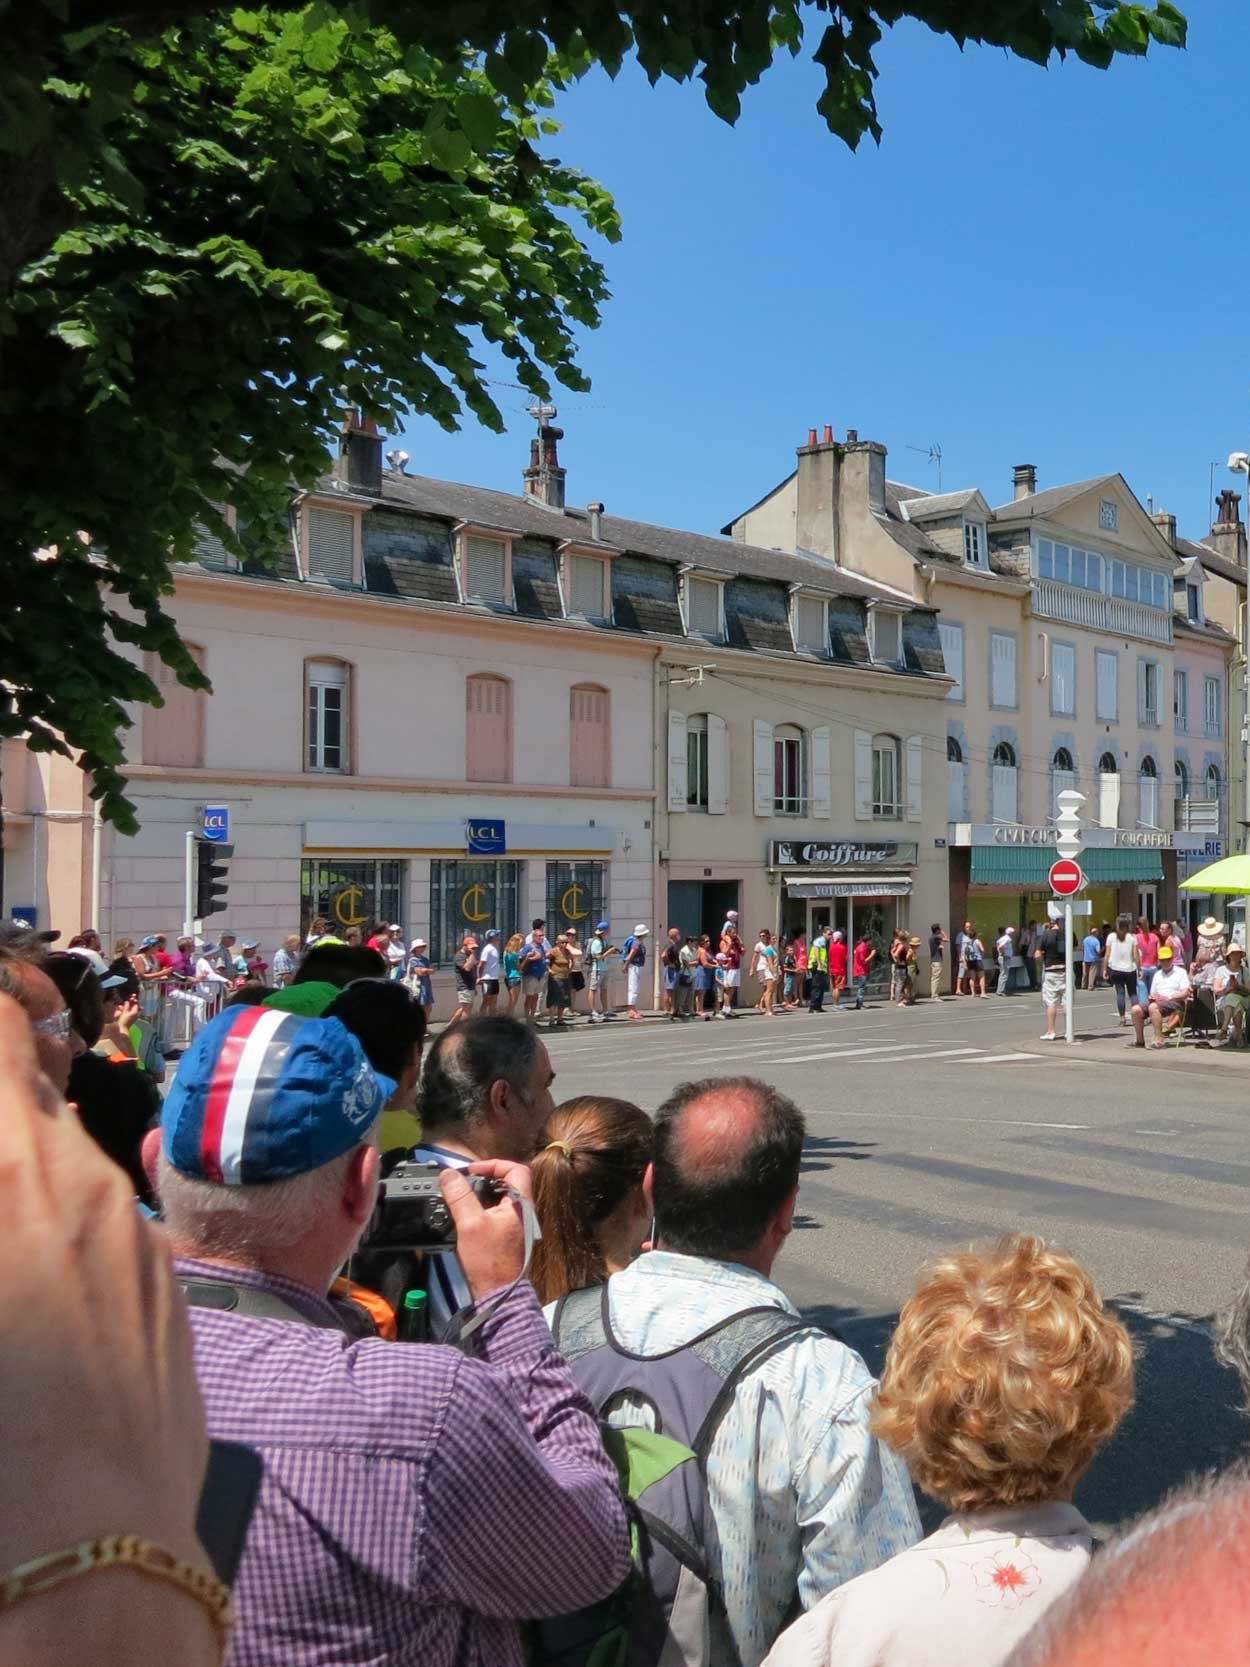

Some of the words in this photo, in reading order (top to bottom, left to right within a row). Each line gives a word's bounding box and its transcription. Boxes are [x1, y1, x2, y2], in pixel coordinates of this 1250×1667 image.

[204, 815, 225, 828] LCL
[470, 826, 500, 840] LCL
[802, 843, 887, 865] Coiffure
[814, 885, 848, 896] VOTRE
